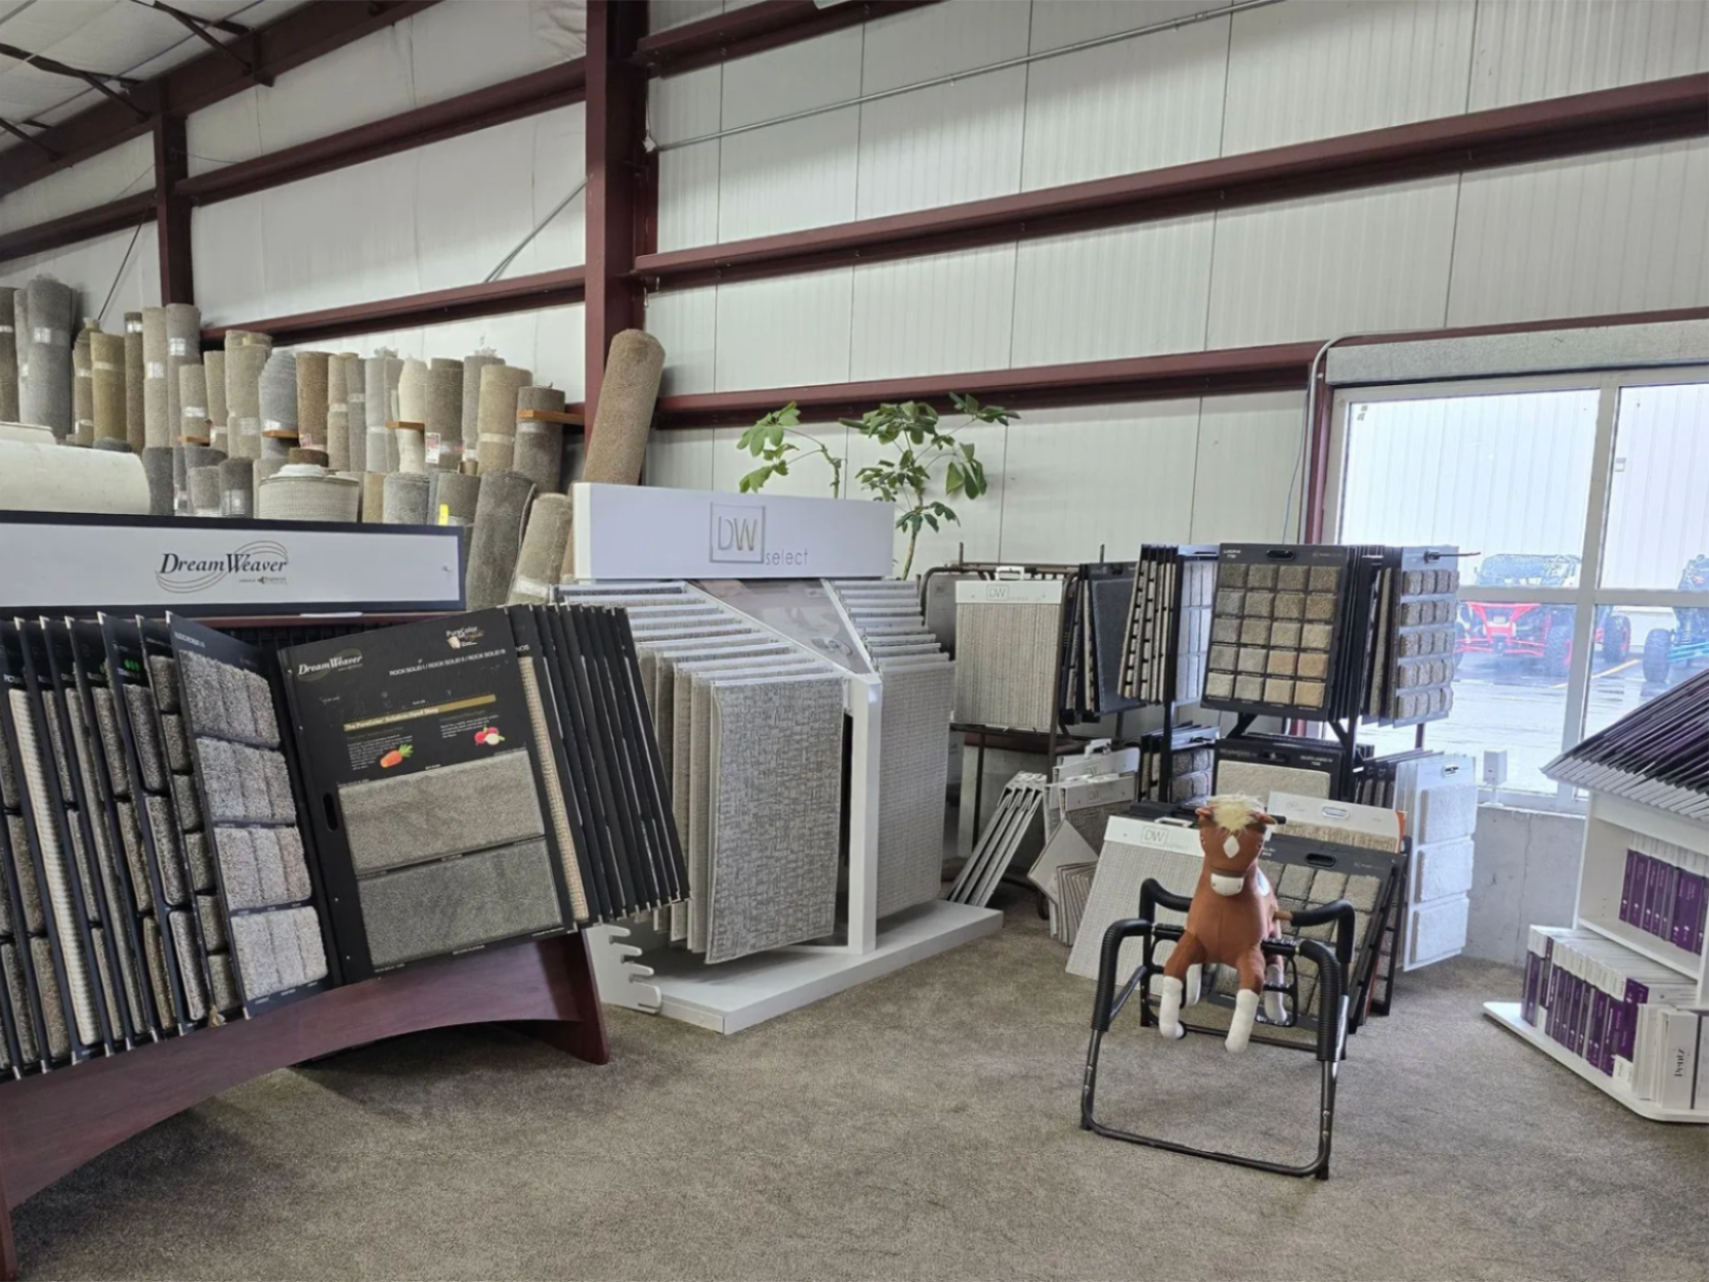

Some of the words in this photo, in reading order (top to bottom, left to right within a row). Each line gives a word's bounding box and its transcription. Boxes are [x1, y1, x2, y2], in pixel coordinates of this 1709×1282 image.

[718, 516, 757, 551] DW
[765, 548, 808, 566] select
[389, 668, 405, 676] ROCK
[1144, 830, 1165, 842] DW
